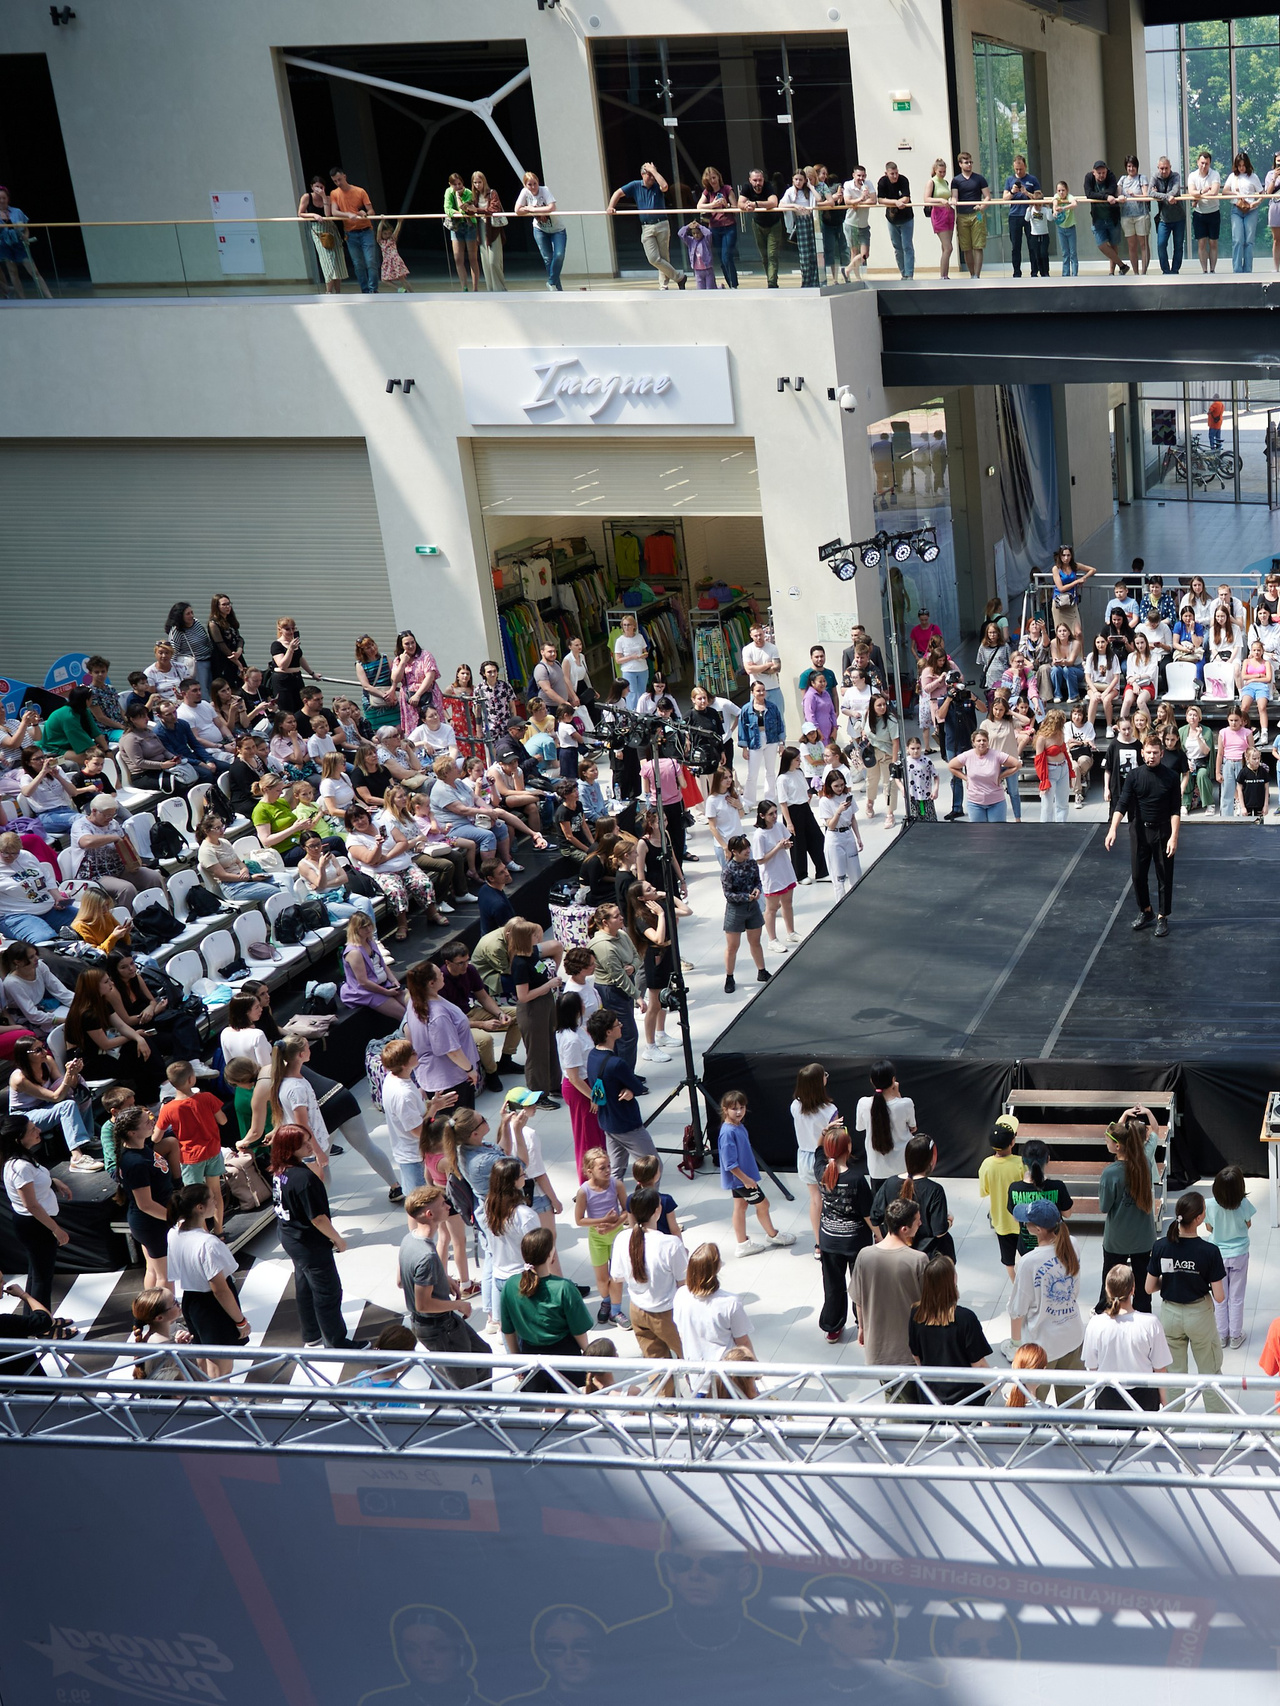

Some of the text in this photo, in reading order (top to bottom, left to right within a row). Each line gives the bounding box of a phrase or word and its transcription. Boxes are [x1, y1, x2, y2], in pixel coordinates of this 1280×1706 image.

[521, 356, 673, 418] Imagine
[1034, 1256, 1059, 1288] EVENT
[1173, 1259, 1196, 1271] AGR
